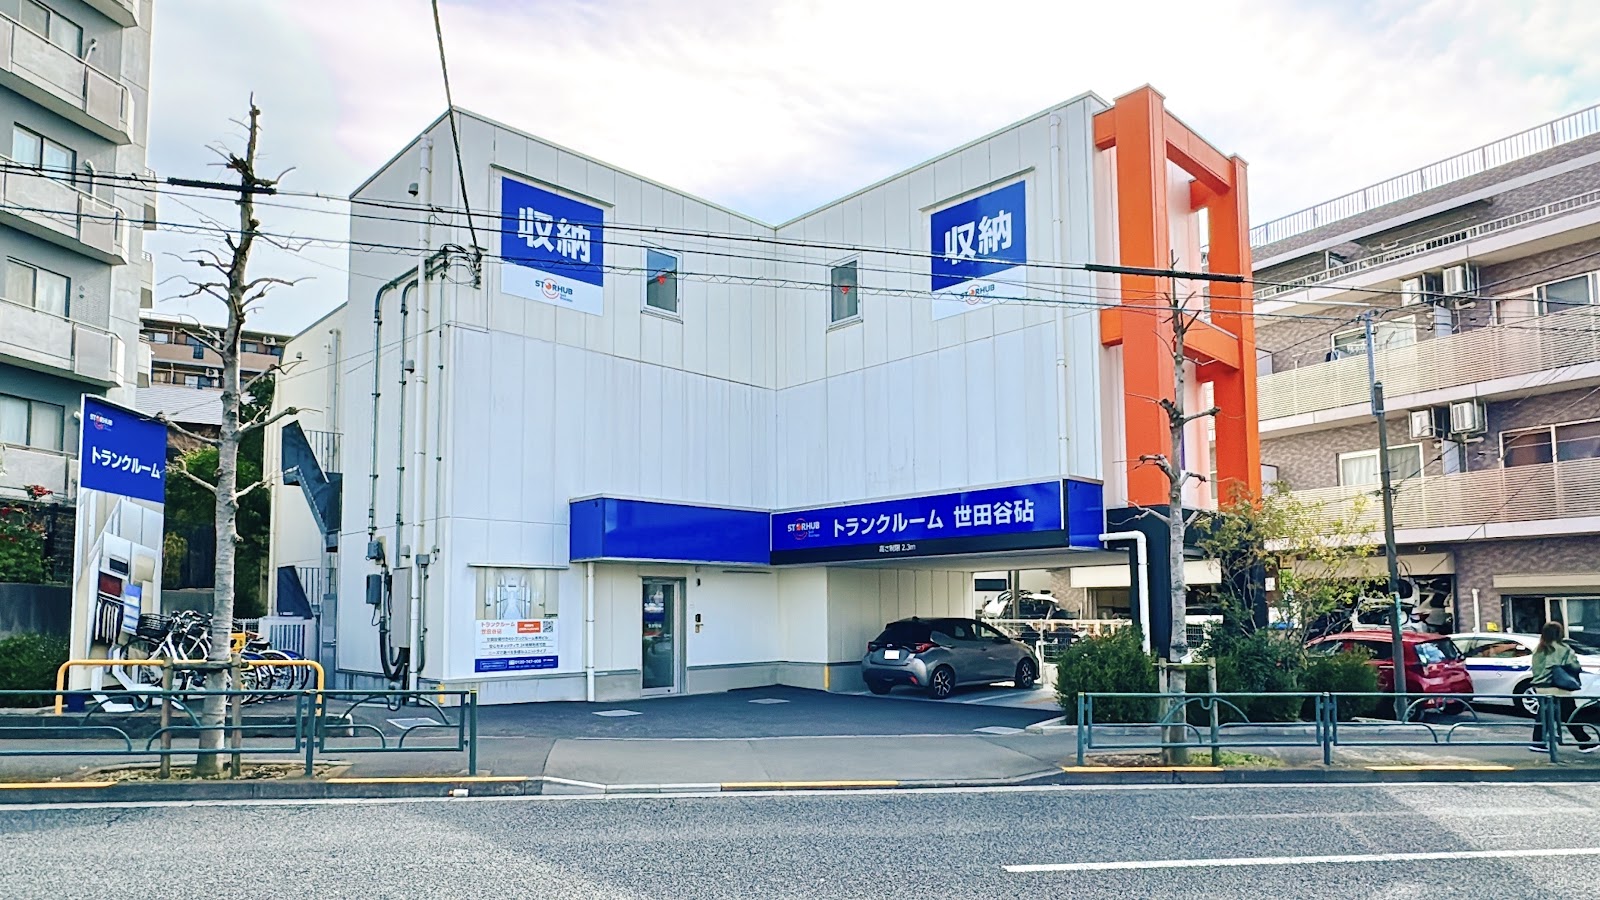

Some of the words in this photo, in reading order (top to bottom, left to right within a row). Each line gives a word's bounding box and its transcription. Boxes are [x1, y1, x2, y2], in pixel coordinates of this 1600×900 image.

[518, 207, 590, 263] 収納
[944, 210, 1012, 265] 収納
[535, 280, 573, 295] STORHUB
[92, 446, 160, 479] トランクルーム
[787, 521, 821, 532] STORHUB
[834, 509, 944, 537] トランクルーム
[953, 499, 1035, 528] 世田谷砧
[878, 544, 900, 553] 高さ制限
[901, 543, 916, 551] 2.3m
